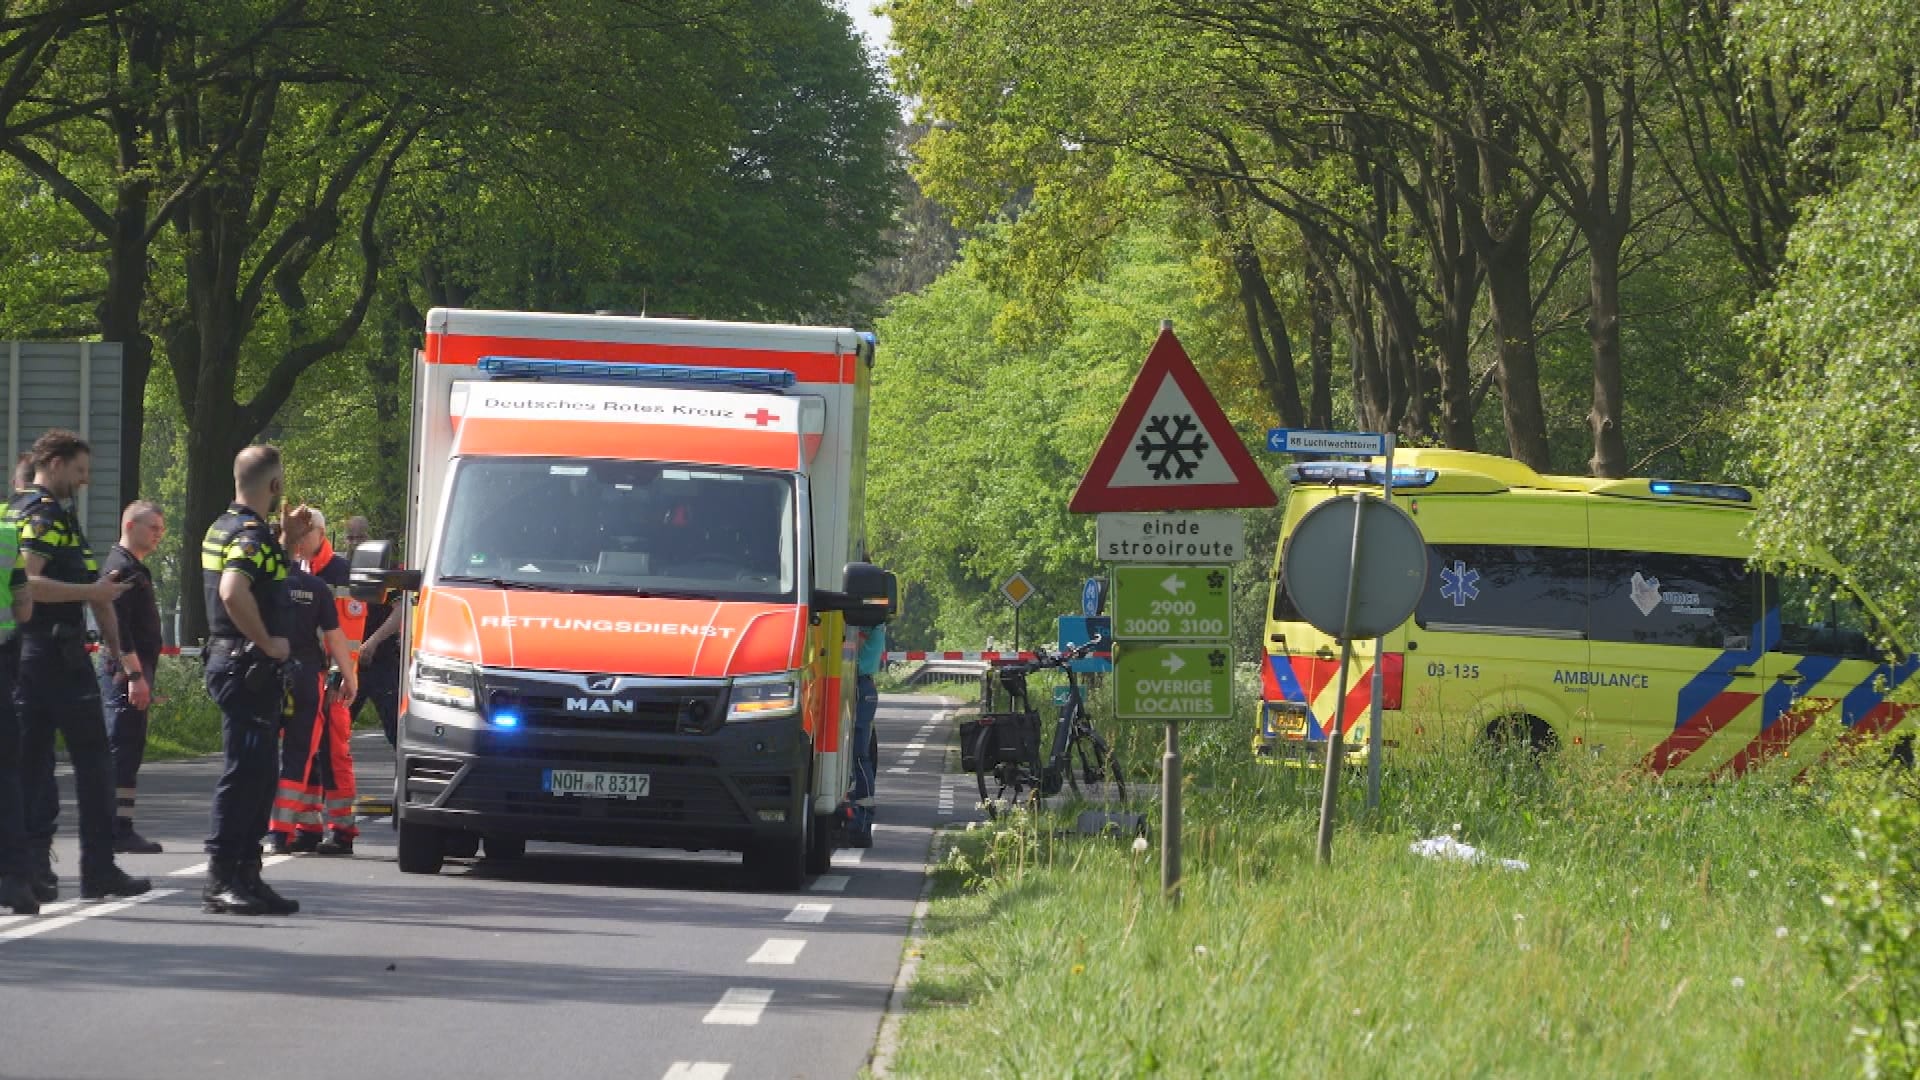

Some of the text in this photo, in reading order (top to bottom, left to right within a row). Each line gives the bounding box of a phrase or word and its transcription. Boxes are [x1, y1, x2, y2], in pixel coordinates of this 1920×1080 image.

[485, 398, 735, 418] Deutsches Rotes Kreuz
[1143, 519, 1200, 535] einde
[1109, 540, 1233, 557] strooiroute
[1151, 600, 1197, 616] 2900
[481, 615, 736, 638] RETTUNGSDIENST
[1125, 618, 1170, 634] 3000
[1180, 618, 1223, 634] 3100
[1427, 661, 1480, 679] 03-135
[1553, 669, 1649, 688] AMBULANCE
[1135, 679, 1213, 695] OVERIGE
[566, 697, 634, 713] MAN
[1135, 697, 1214, 713] LOCATIES
[552, 773, 649, 793] NOH R 8317
